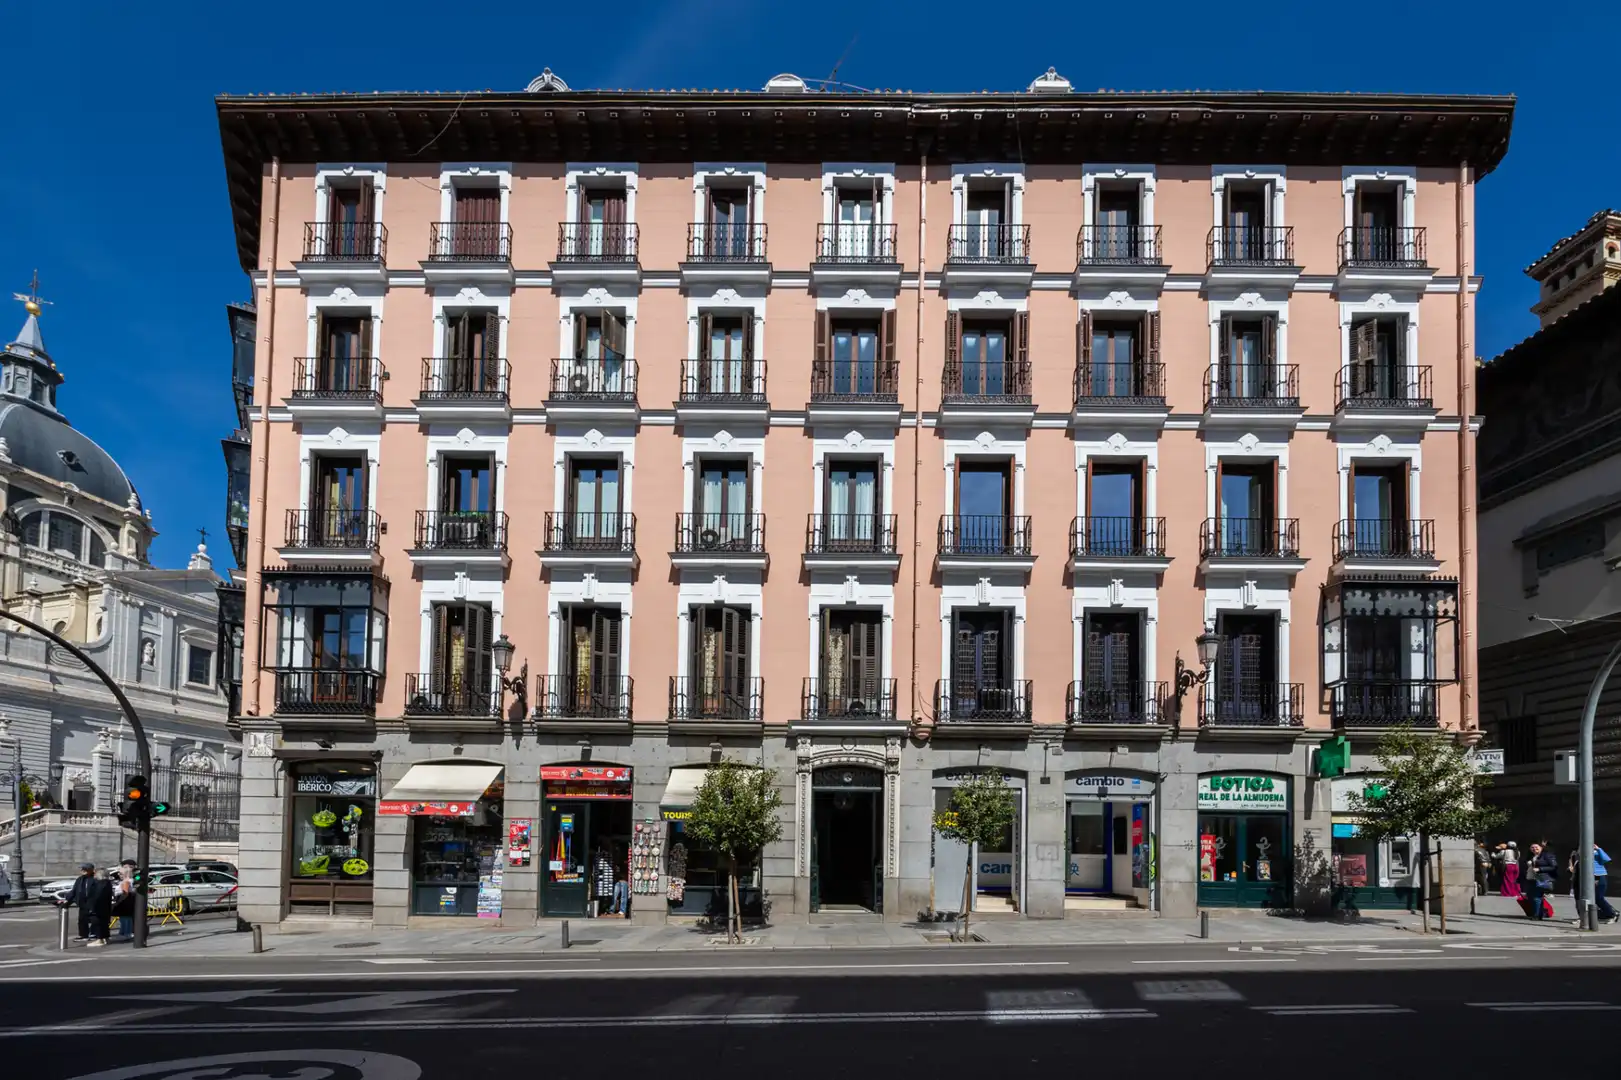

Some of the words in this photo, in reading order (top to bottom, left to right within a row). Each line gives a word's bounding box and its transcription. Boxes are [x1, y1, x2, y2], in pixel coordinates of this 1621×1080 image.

[1076, 776, 1124, 786] cambio
[1210, 776, 1274, 792] BOTICA
[1198, 793, 1218, 801] REAL
[1220, 793, 1231, 801] DE
[1232, 794, 1243, 802] LA
[1243, 794, 1284, 802] ALMUDENA
